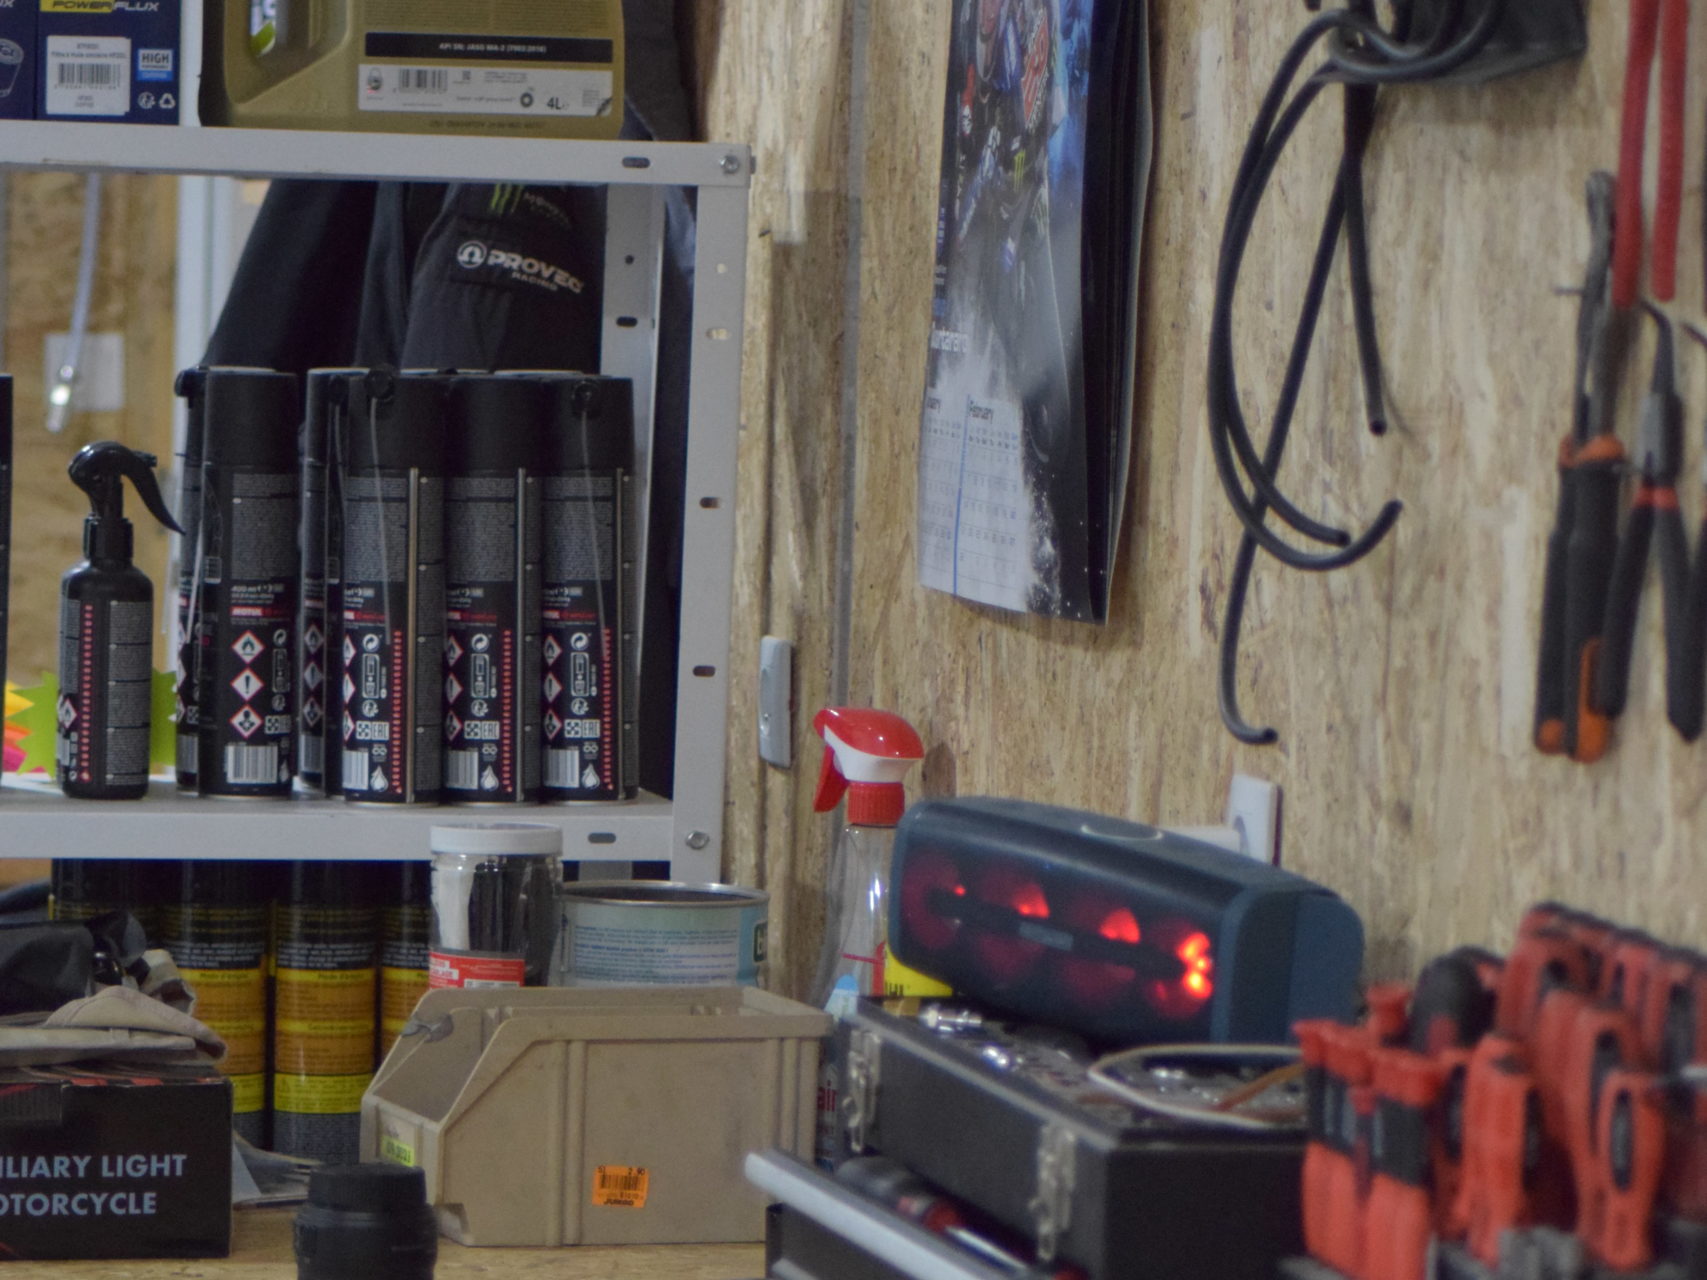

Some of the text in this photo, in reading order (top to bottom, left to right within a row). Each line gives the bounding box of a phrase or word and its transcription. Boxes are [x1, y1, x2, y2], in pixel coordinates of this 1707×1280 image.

[52, 0, 160, 12] POWERFLUX
[141, 53, 170, 64] HIGH
[101, 1153, 188, 1178] LIGHT
